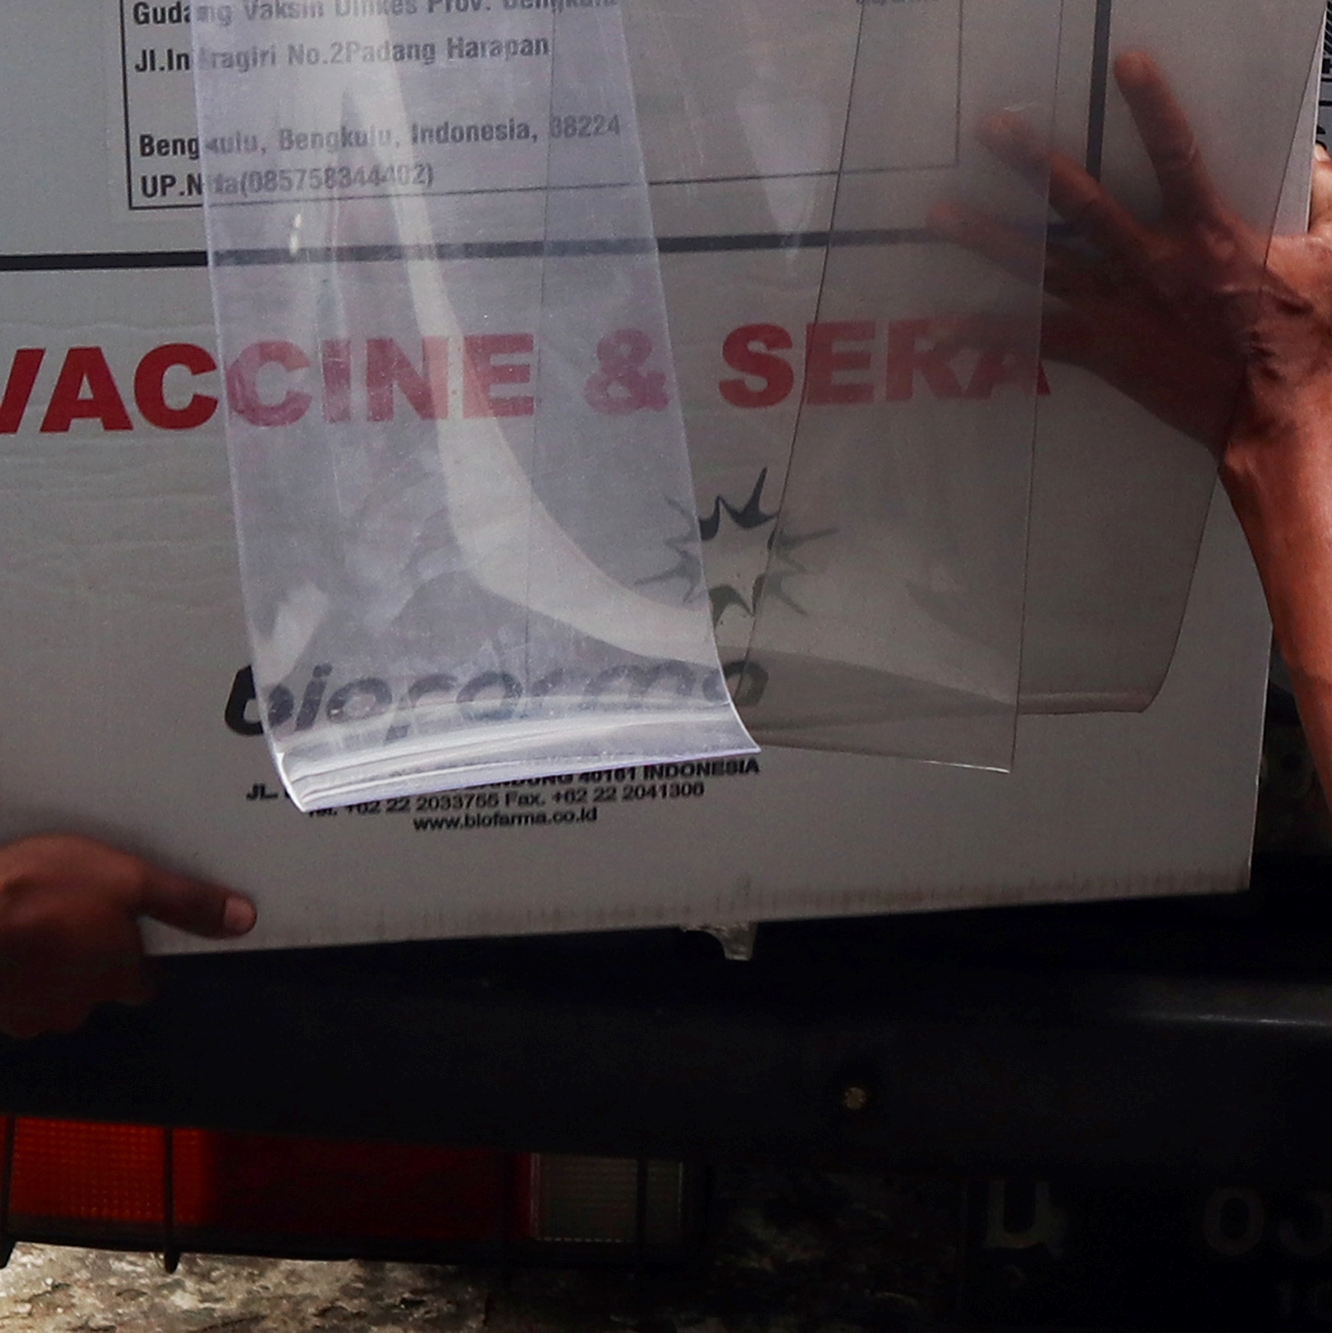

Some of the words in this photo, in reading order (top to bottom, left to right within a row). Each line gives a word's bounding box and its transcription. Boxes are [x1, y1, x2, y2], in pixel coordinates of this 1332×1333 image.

[447, 32, 549, 65] Harapan
[410, 116, 539, 148] Indonesia,
[585, 328, 670, 415] &
[718, 317, 1052, 410] SERA
[642, 756, 761, 781] INDONESIA
[504, 790, 547, 809] Fax.
[552, 787, 588, 805] +62
[592, 785, 619, 804] 22
